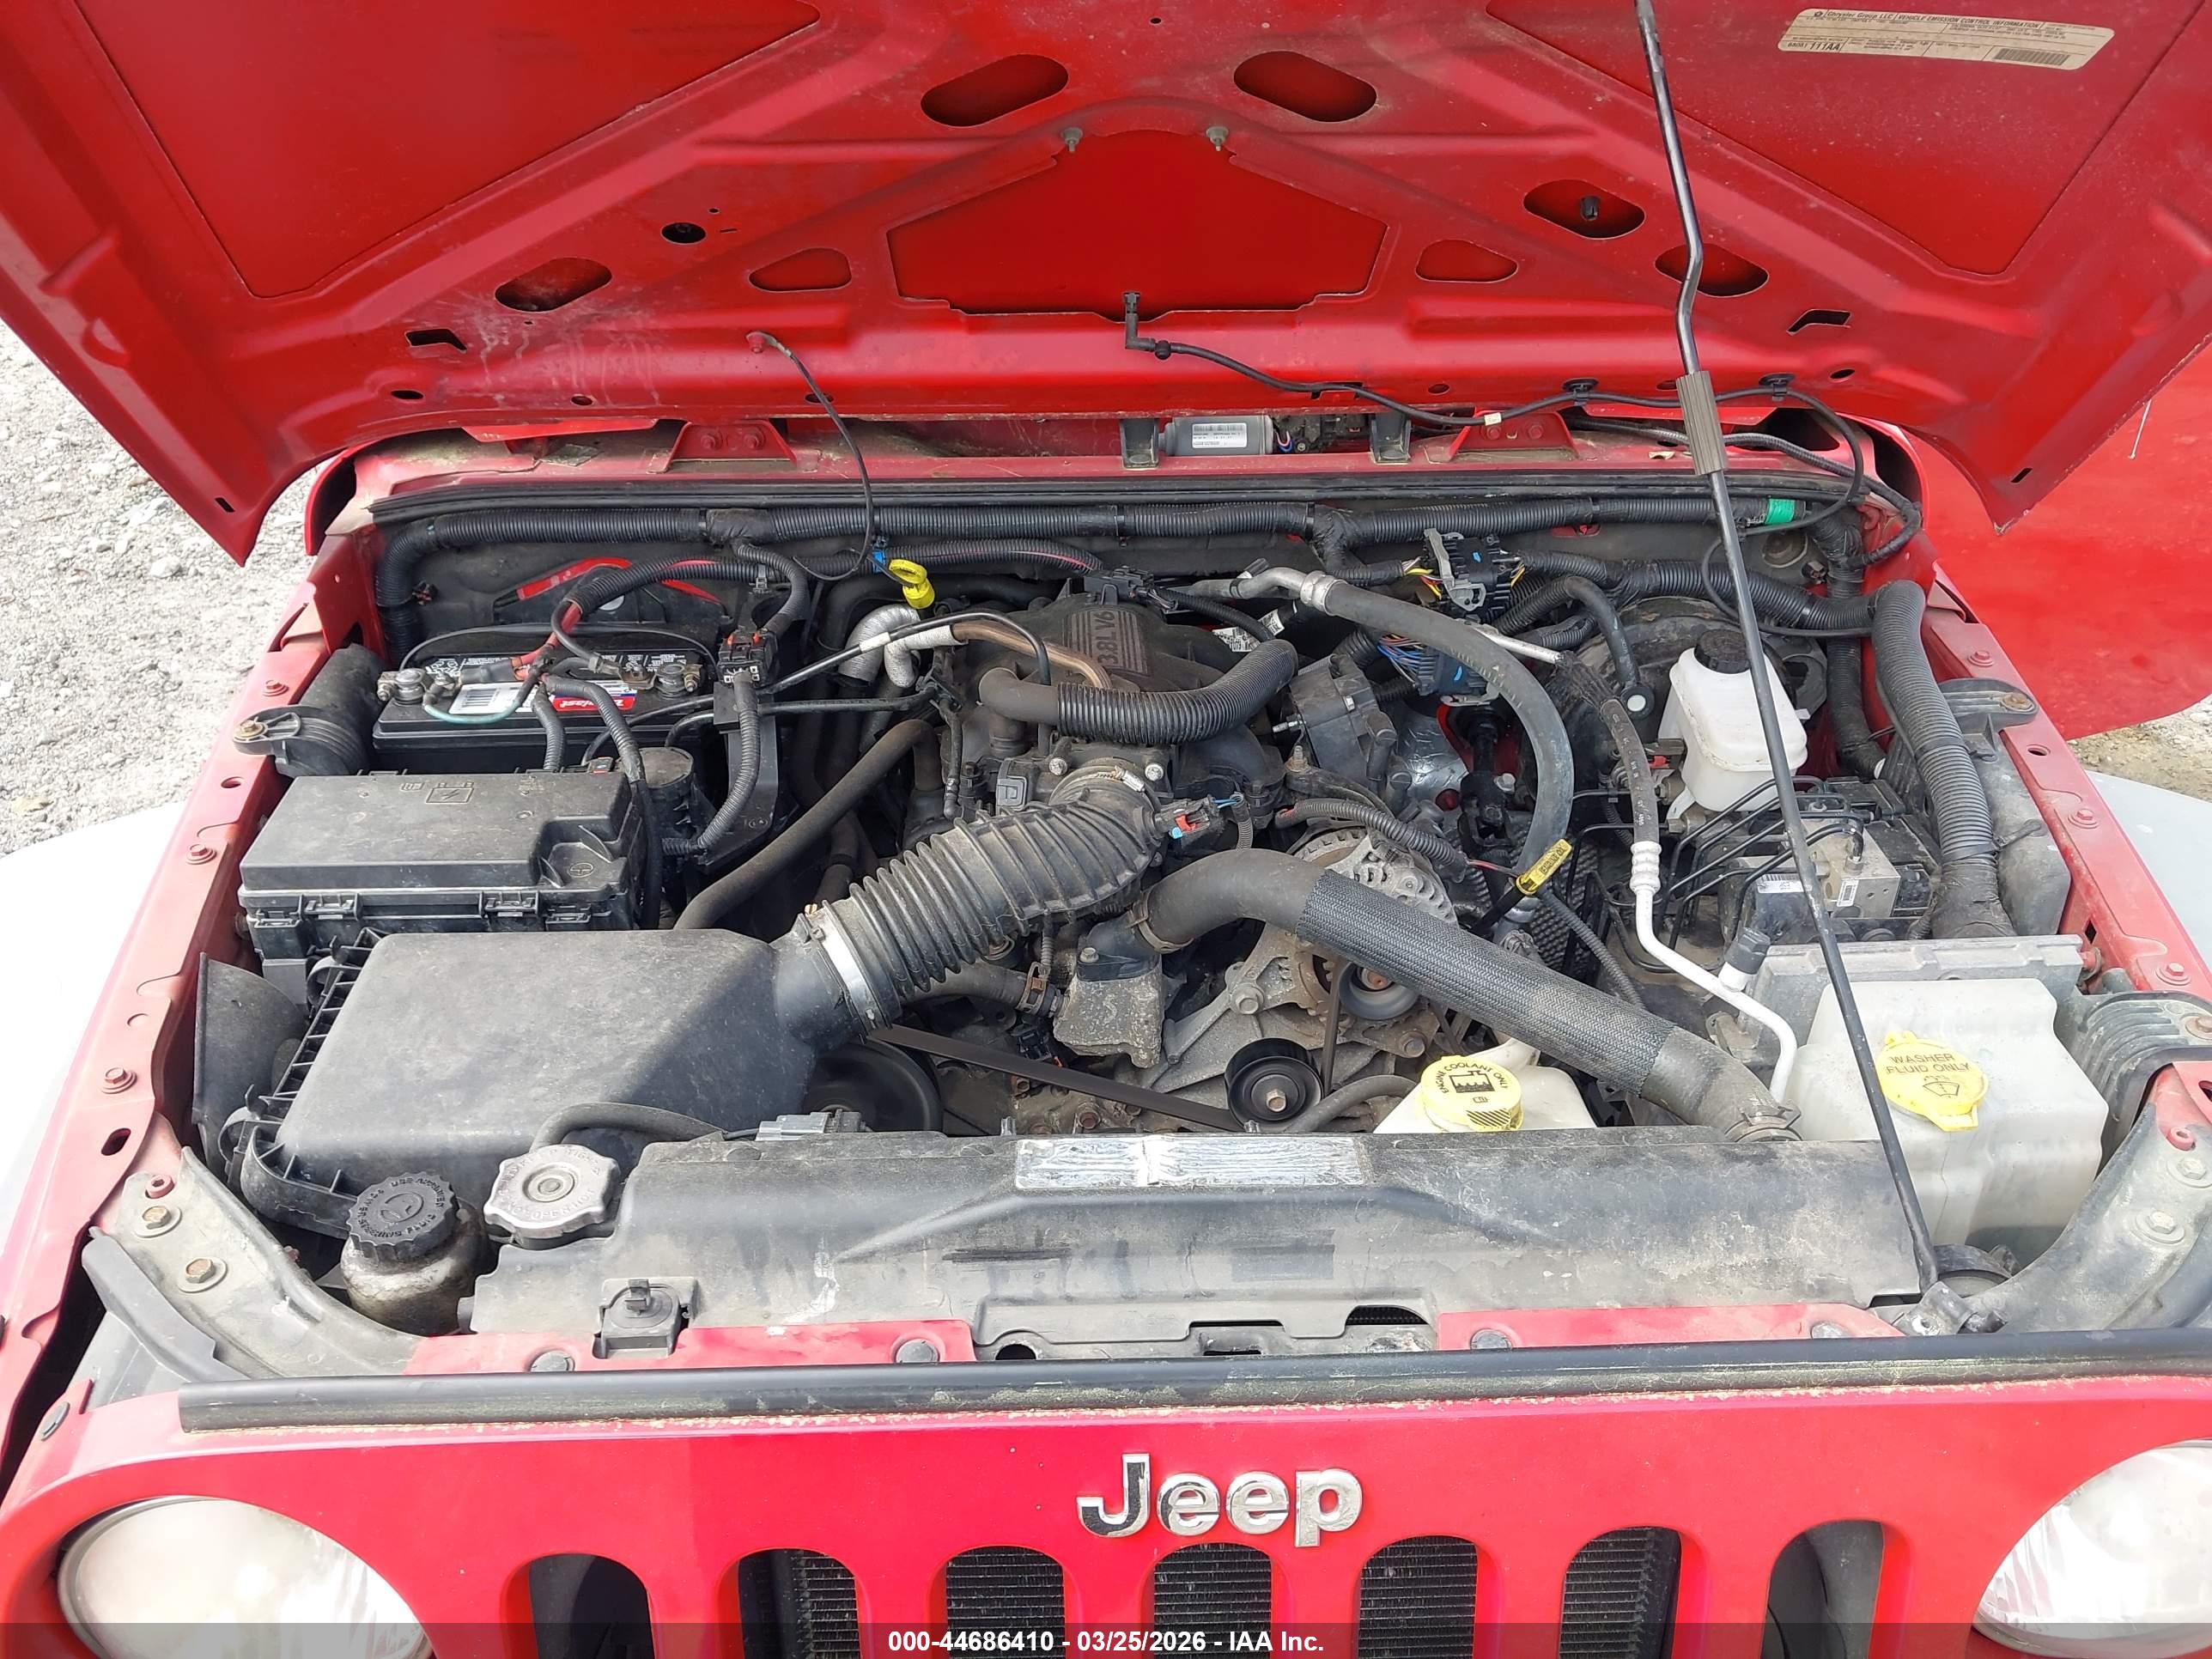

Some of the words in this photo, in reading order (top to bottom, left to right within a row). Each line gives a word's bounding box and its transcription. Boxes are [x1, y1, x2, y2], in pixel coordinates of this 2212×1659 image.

[1992, 20, 2043, 28] INFORMATION
[1093, 611, 1115, 630] V6
[1097, 630, 1119, 665] 3.8L
[1889, 1053, 1956, 1064] WASHER
[1886, 1064, 1929, 1074] FLUID
[1932, 1061, 1971, 1073] ONLY
[1435, 1070, 1449, 1094] ENGINE
[1443, 1061, 1493, 1073] COOLANT
[1492, 1072, 1509, 1090] ONLY
[531, 1206, 570, 1220] OPEN
[1076, 1452, 1363, 1547] Jeep
